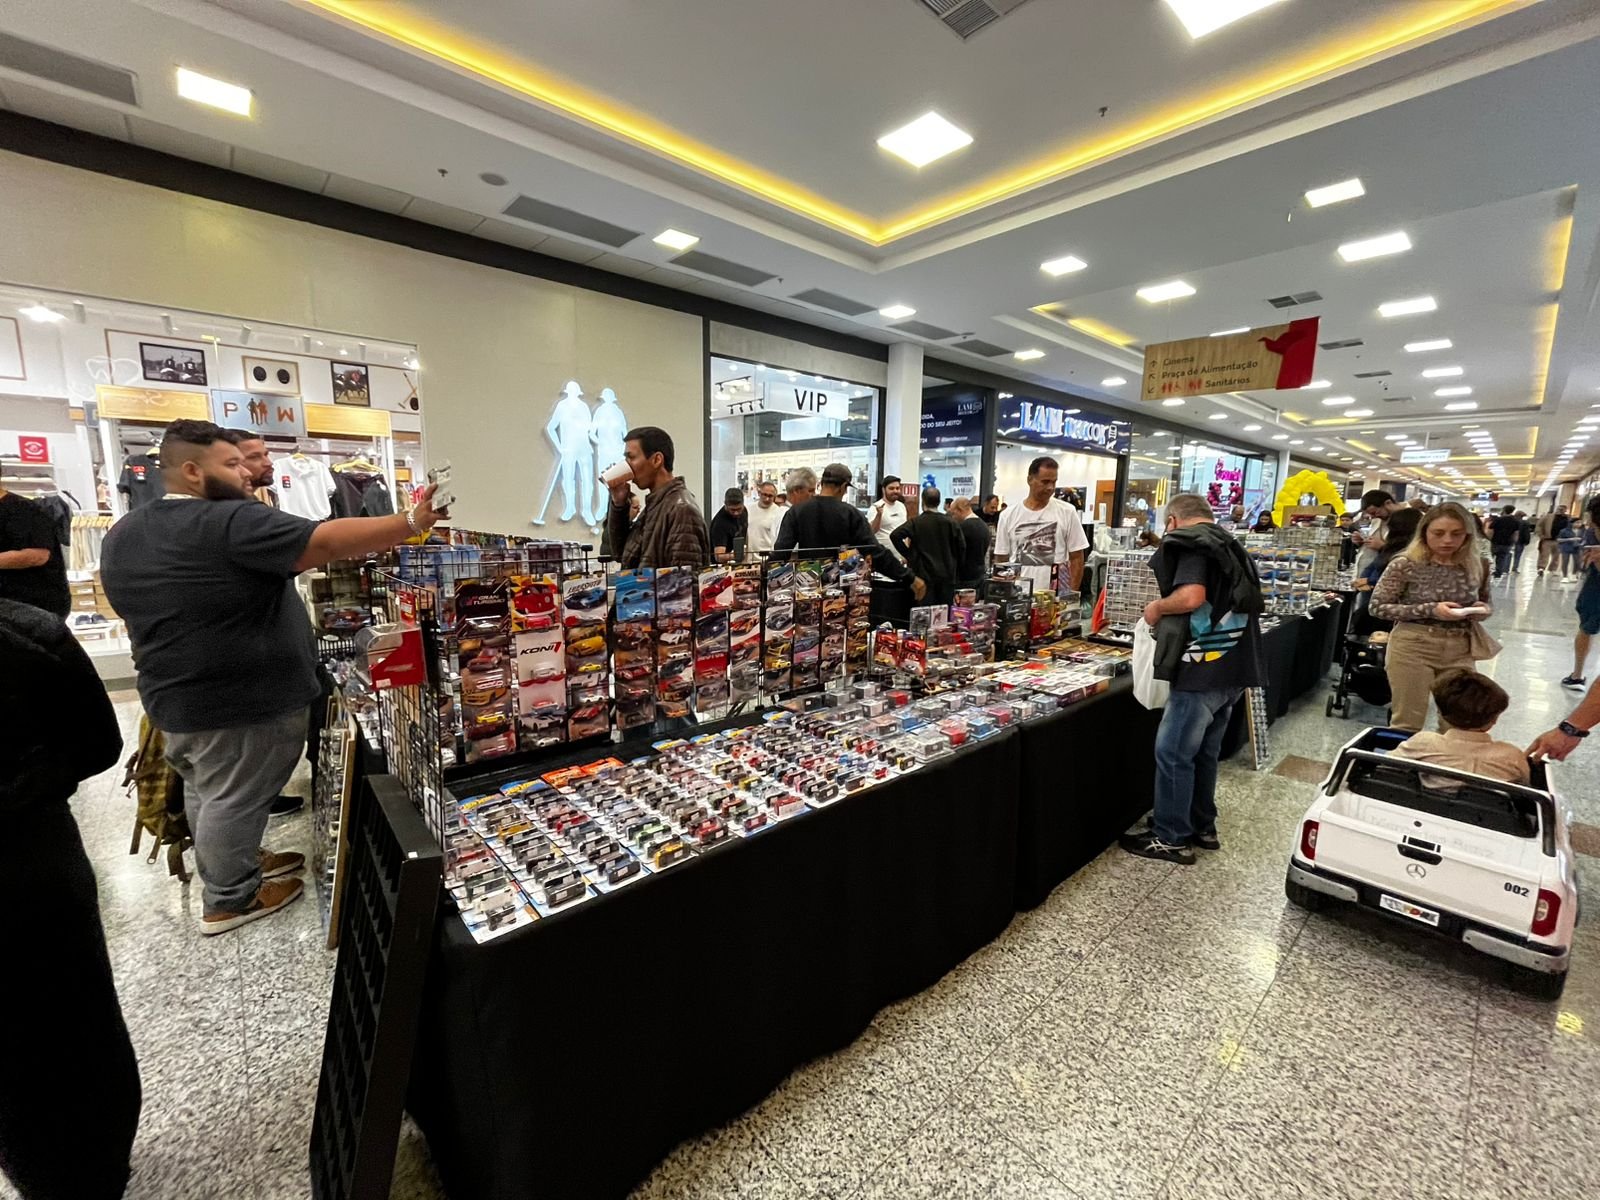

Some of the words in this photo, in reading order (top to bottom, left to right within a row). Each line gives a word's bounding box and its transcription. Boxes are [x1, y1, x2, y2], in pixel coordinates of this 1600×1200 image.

[794, 388, 828, 413] VIP
[223, 402, 239, 418] P
[1504, 882, 1530, 898] 002
